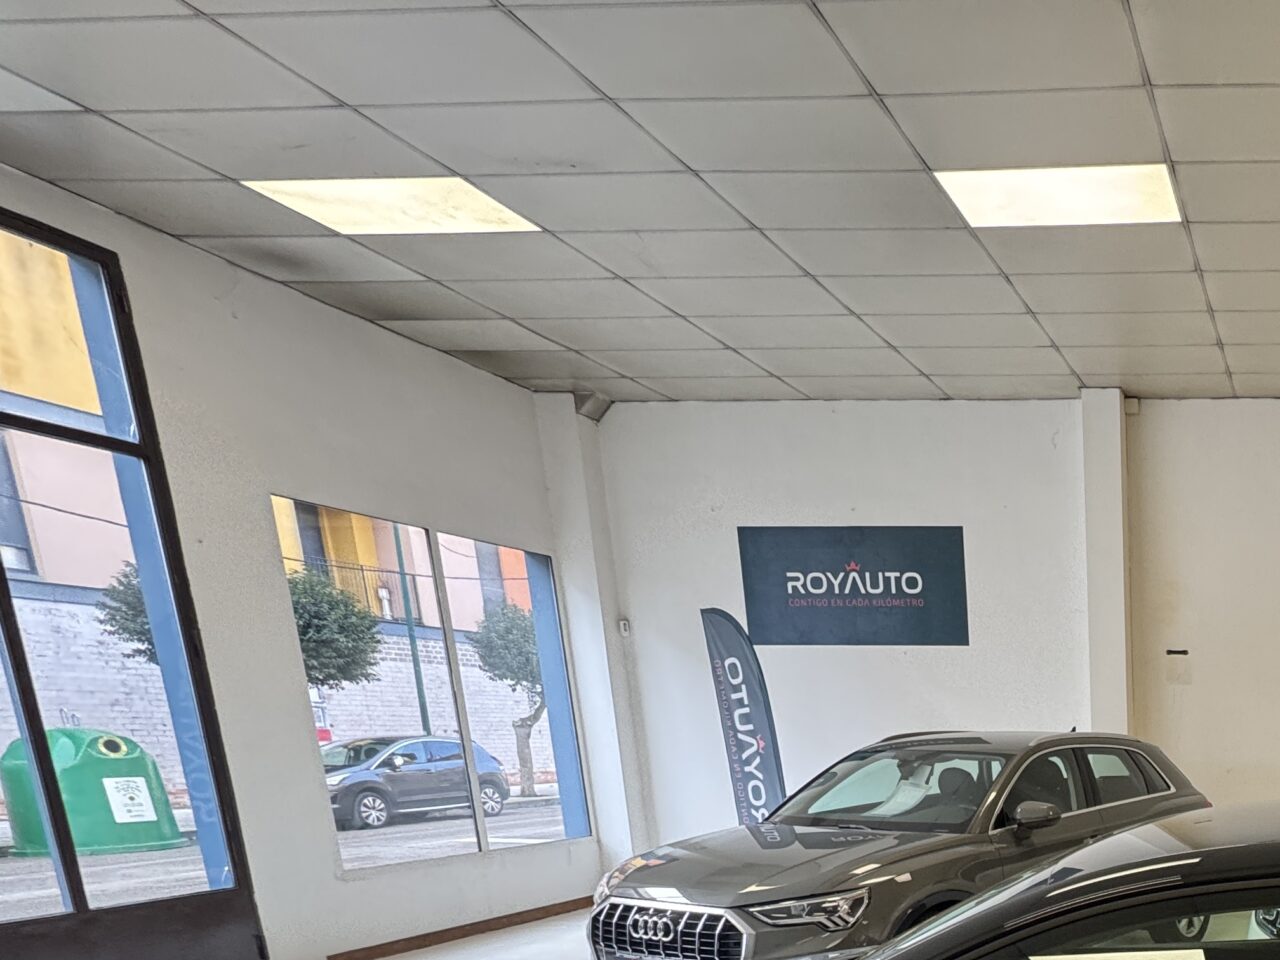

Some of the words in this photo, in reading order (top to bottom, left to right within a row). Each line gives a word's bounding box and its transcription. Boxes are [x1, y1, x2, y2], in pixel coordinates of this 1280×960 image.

[785, 571, 923, 594] ROYAUTO
[788, 598, 828, 607] CONTIGO
[832, 598, 843, 607] EN
[845, 598, 870, 607] CADA
